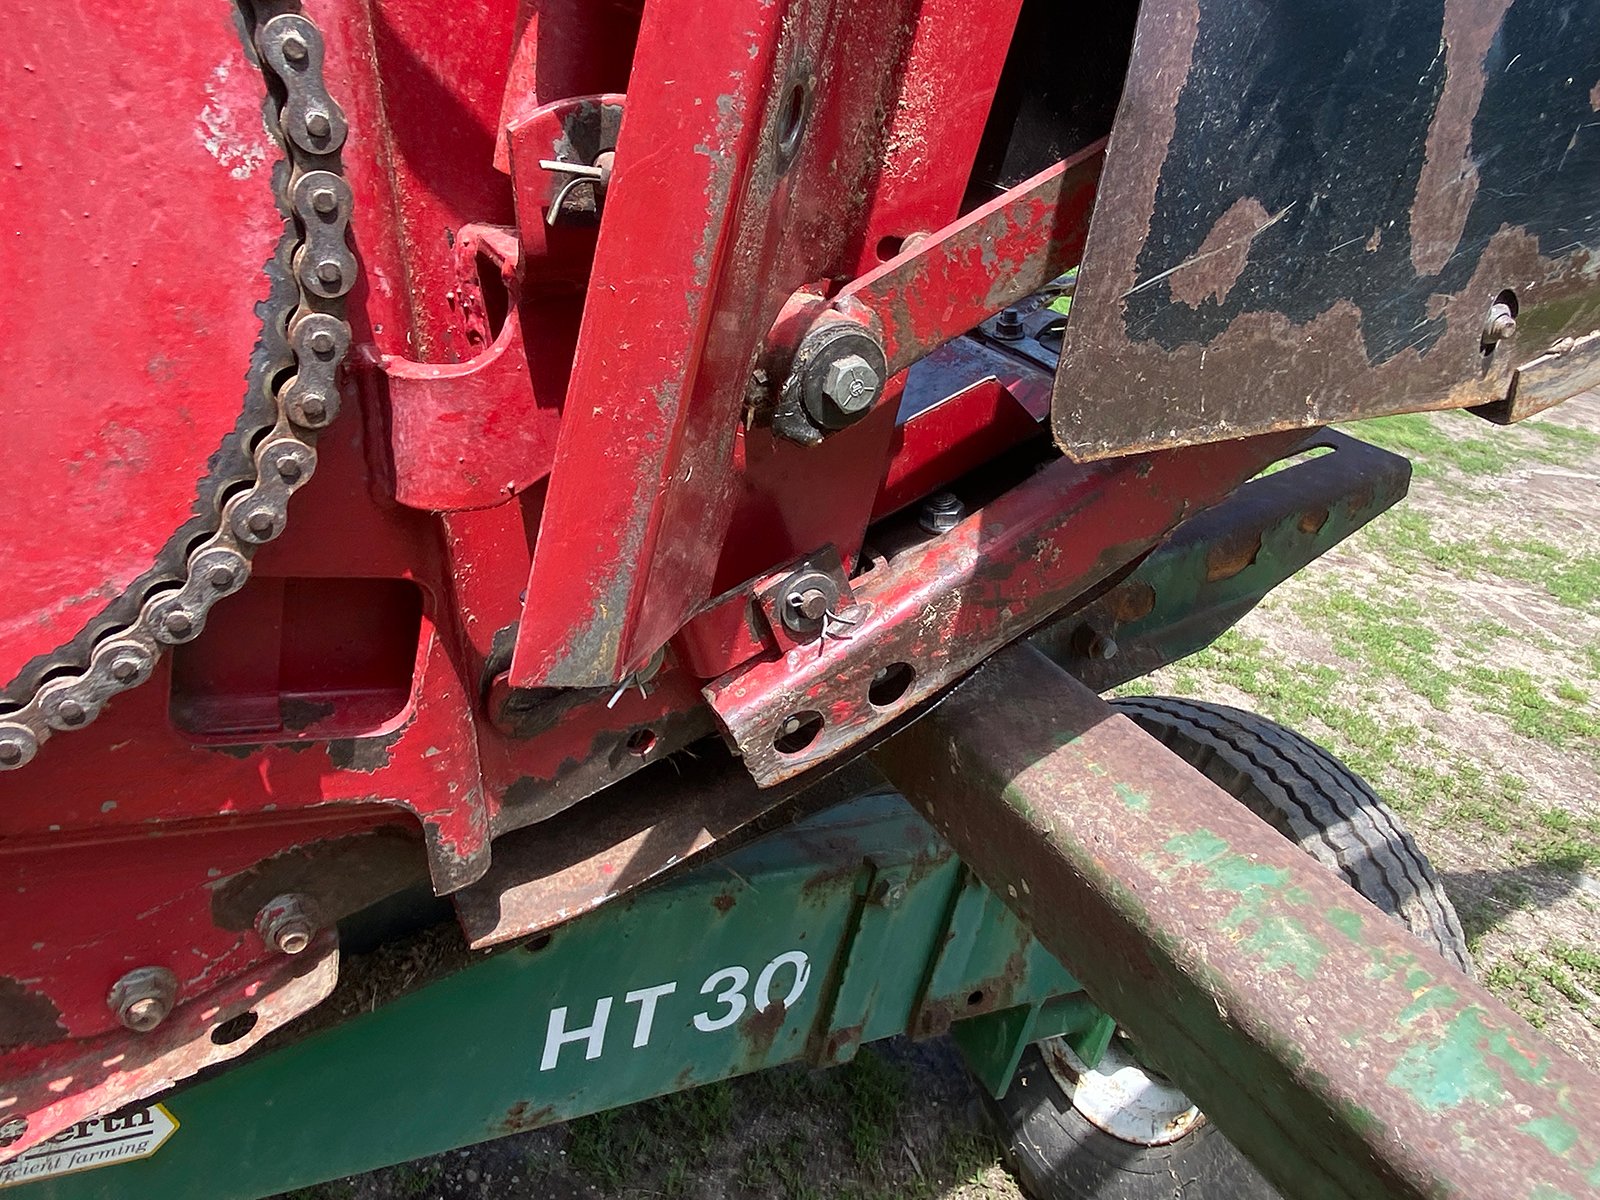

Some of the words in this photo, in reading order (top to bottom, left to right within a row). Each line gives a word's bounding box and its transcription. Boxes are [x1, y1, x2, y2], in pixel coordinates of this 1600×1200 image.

[539, 981, 678, 1072] HT
[693, 950, 811, 1032] 30
[67, 1140, 150, 1169] farming
